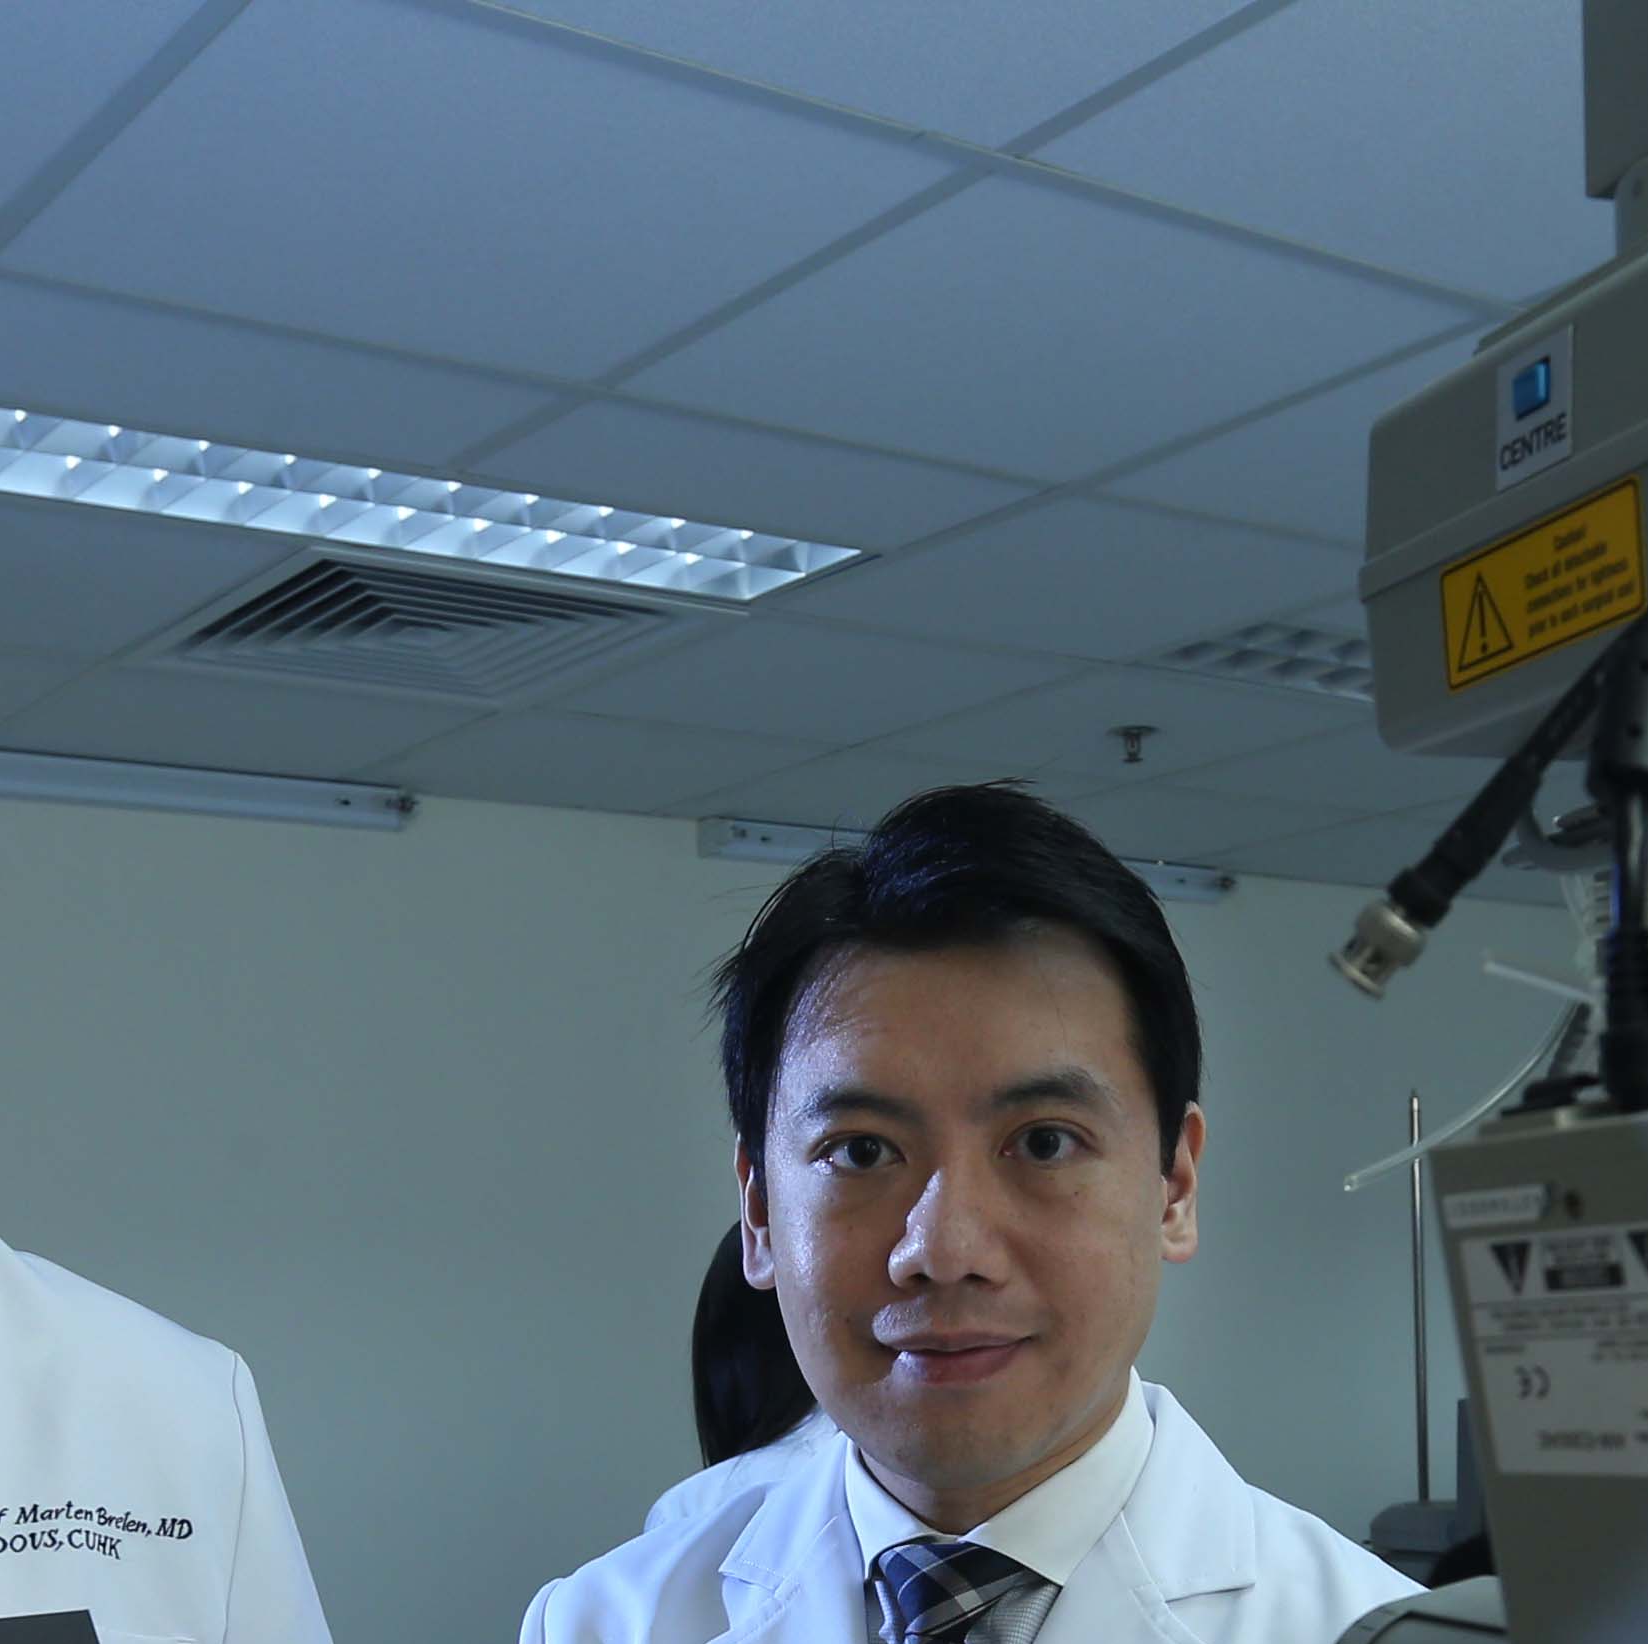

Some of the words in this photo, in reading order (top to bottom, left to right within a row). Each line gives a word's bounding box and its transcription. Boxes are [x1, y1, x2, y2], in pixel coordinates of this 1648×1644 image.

[1501, 411, 1567, 471] CENTRE
[15, 1501, 94, 1525] Marten
[96, 1506, 152, 1537] Brelen,
[155, 1517, 193, 1540] MD
[67, 1528, 122, 1560] CUHK
